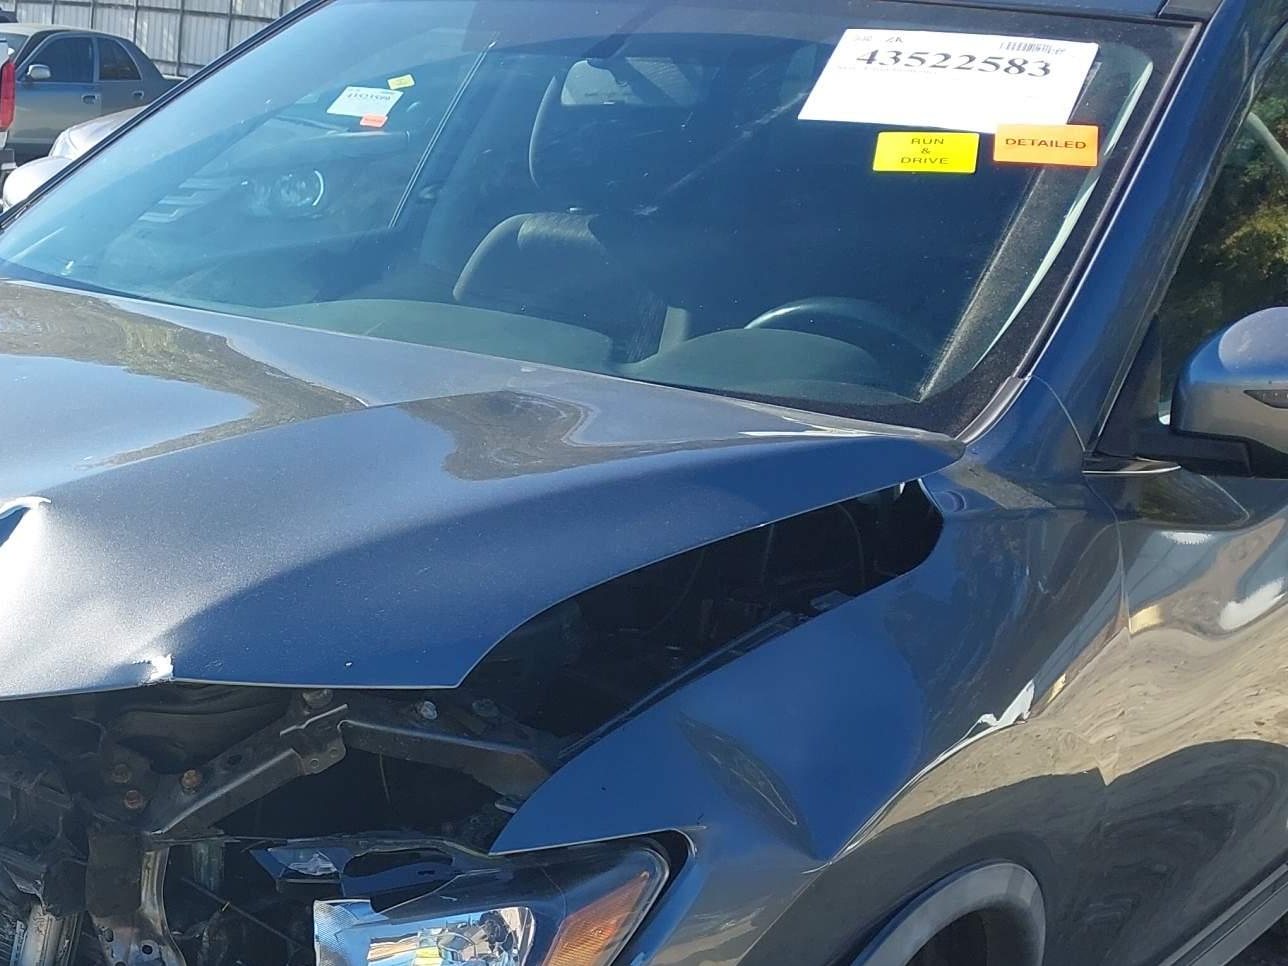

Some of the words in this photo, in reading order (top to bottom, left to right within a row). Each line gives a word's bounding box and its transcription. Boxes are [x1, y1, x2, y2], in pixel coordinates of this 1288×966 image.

[856, 48, 1051, 78] 43522583
[910, 137, 945, 145] RUN
[1005, 137, 1087, 150] DETAILED
[920, 147, 932, 155] &
[900, 156, 949, 165] DRIVE
